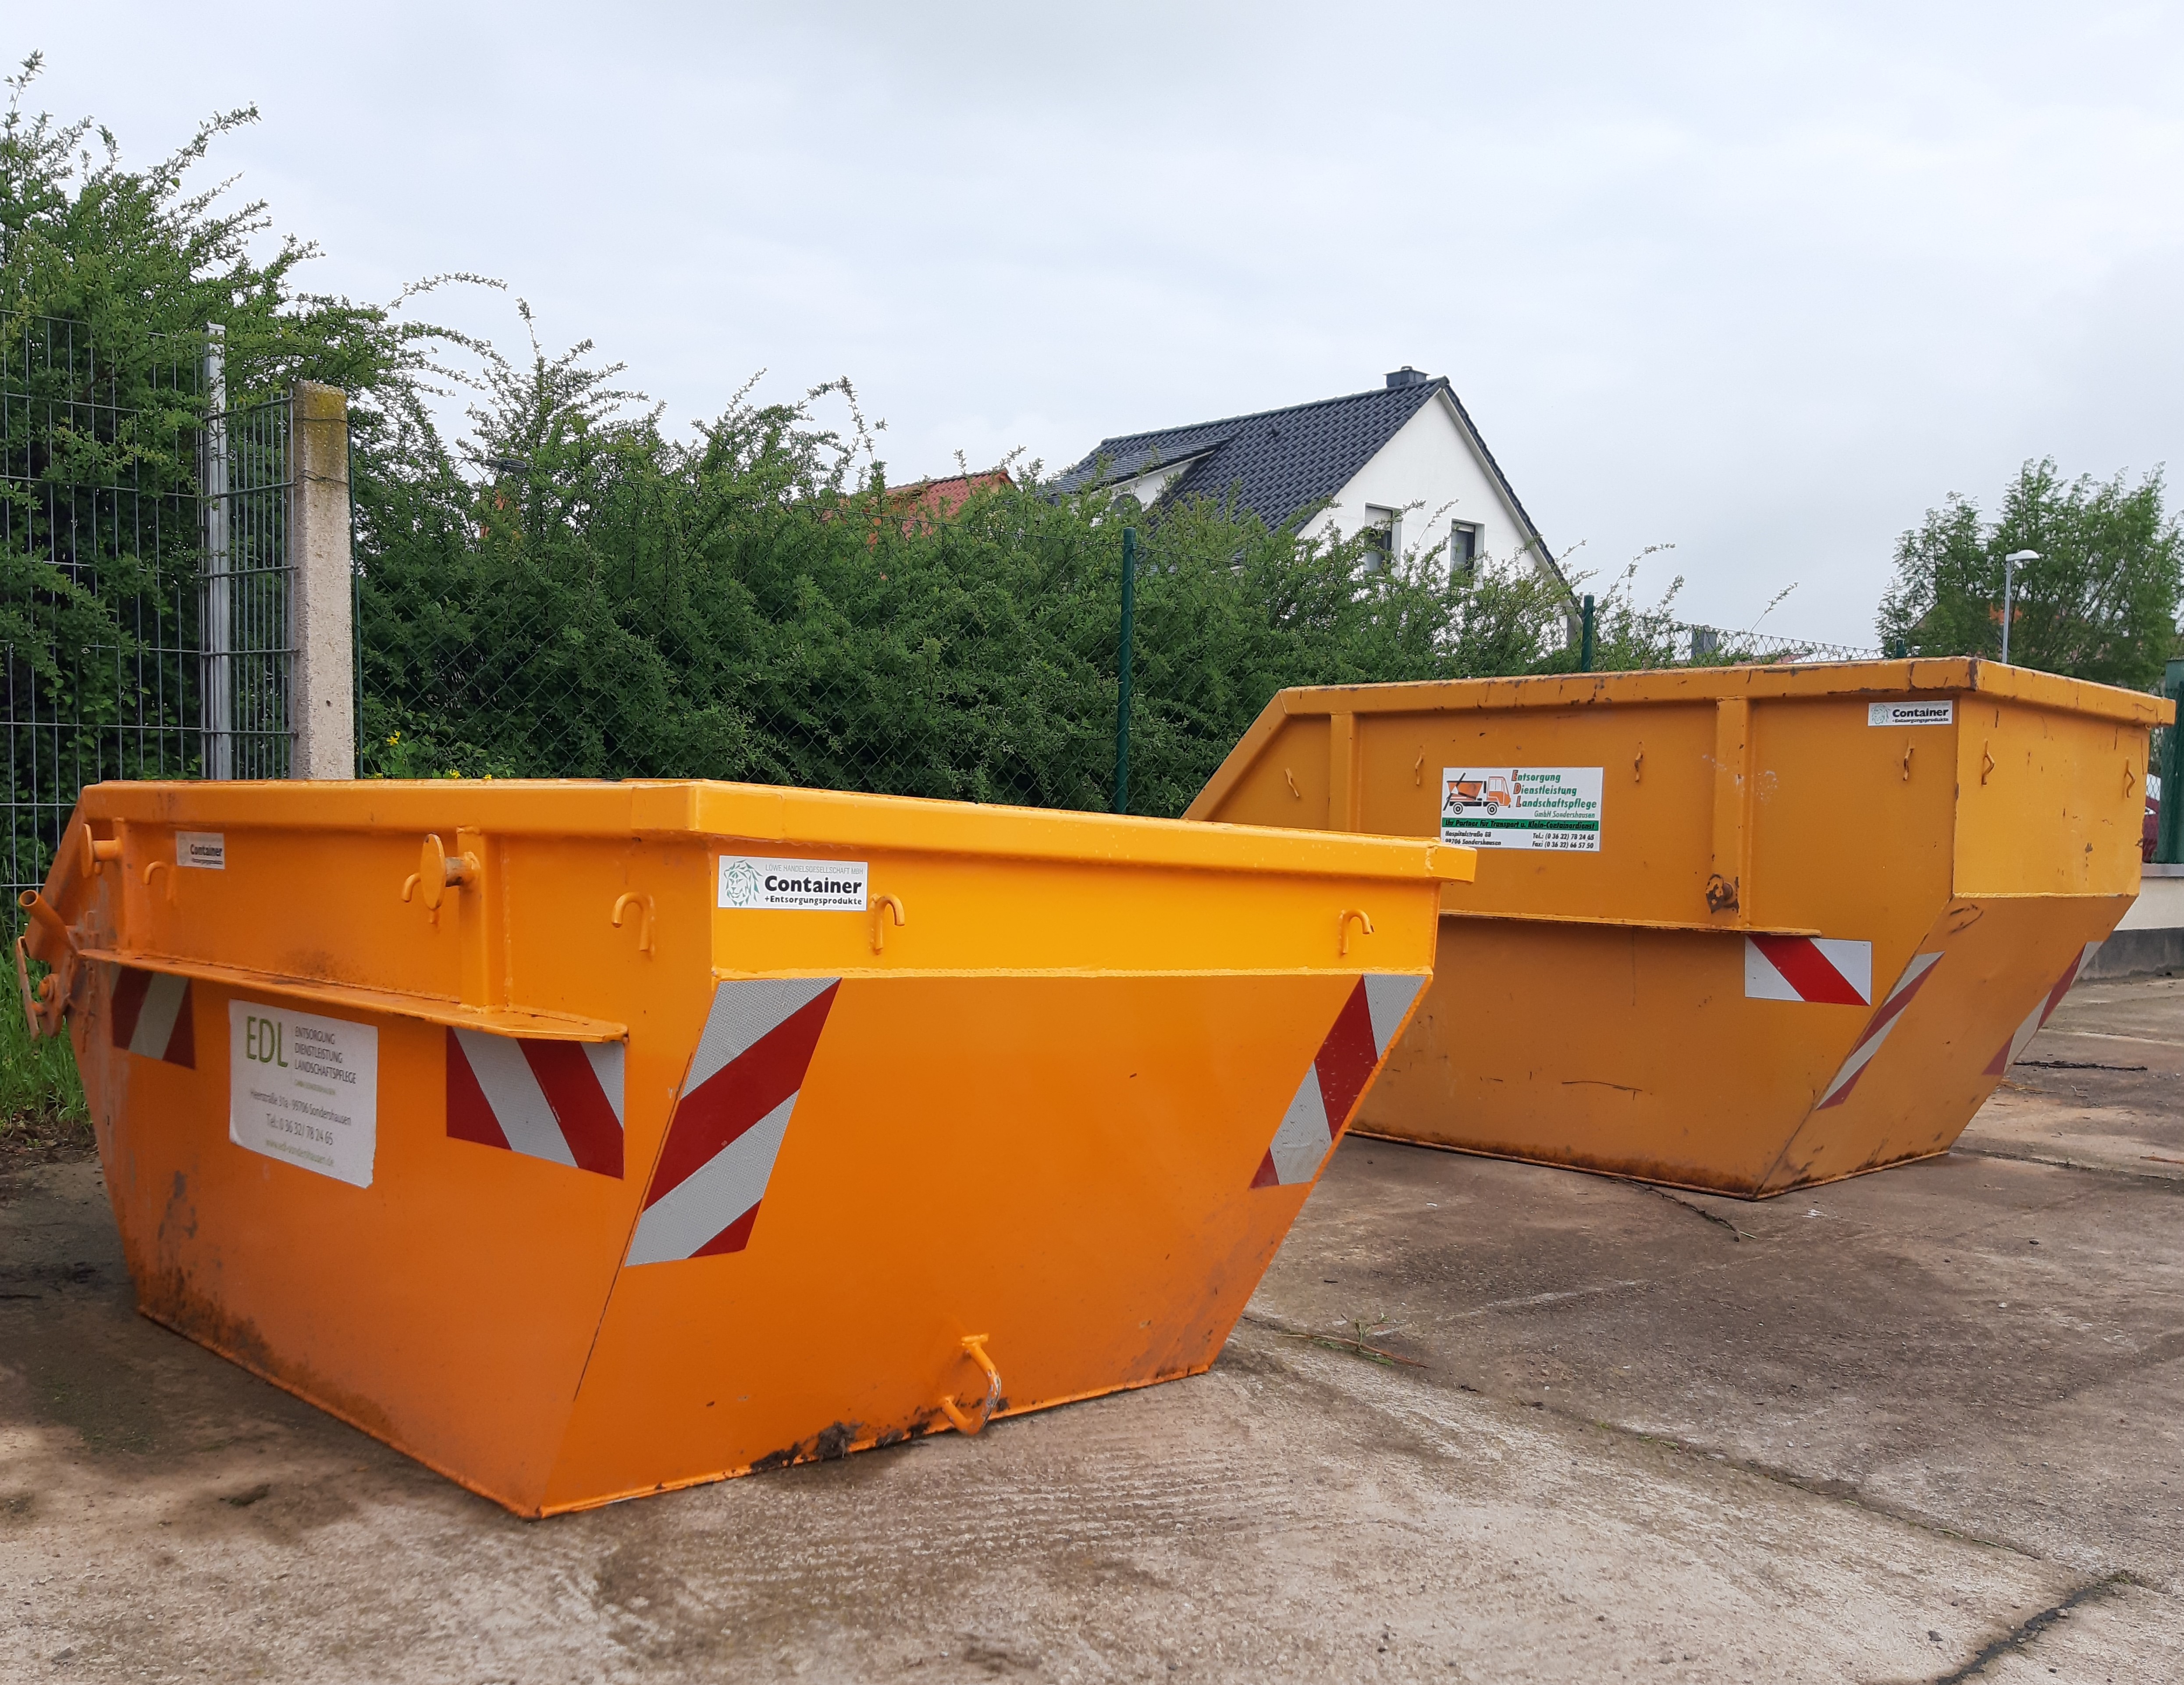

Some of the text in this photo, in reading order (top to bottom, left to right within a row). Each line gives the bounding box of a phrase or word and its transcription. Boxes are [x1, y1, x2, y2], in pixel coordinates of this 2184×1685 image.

[1892, 708, 1949, 717] Container
[1511, 769, 1561, 783] Entsorgung
[1513, 783, 1577, 796] Dienstleistung
[1515, 795, 1597, 810] Landschaftspflege
[190, 844, 222, 856] Container
[783, 864, 850, 874] HANDELSGESELLSCHAFT
[765, 875, 862, 894] Container
[765, 895, 862, 906] +Entsorgungsprodukte
[247, 1016, 288, 1067] EDL
[295, 1026, 335, 1044] ENTSORGUNG
[295, 1042, 343, 1064] DIENSTLEISTUNG
[295, 1059, 356, 1084] LANDSCHAFTSPFLEGE
[325, 1131, 334, 1145] 65
